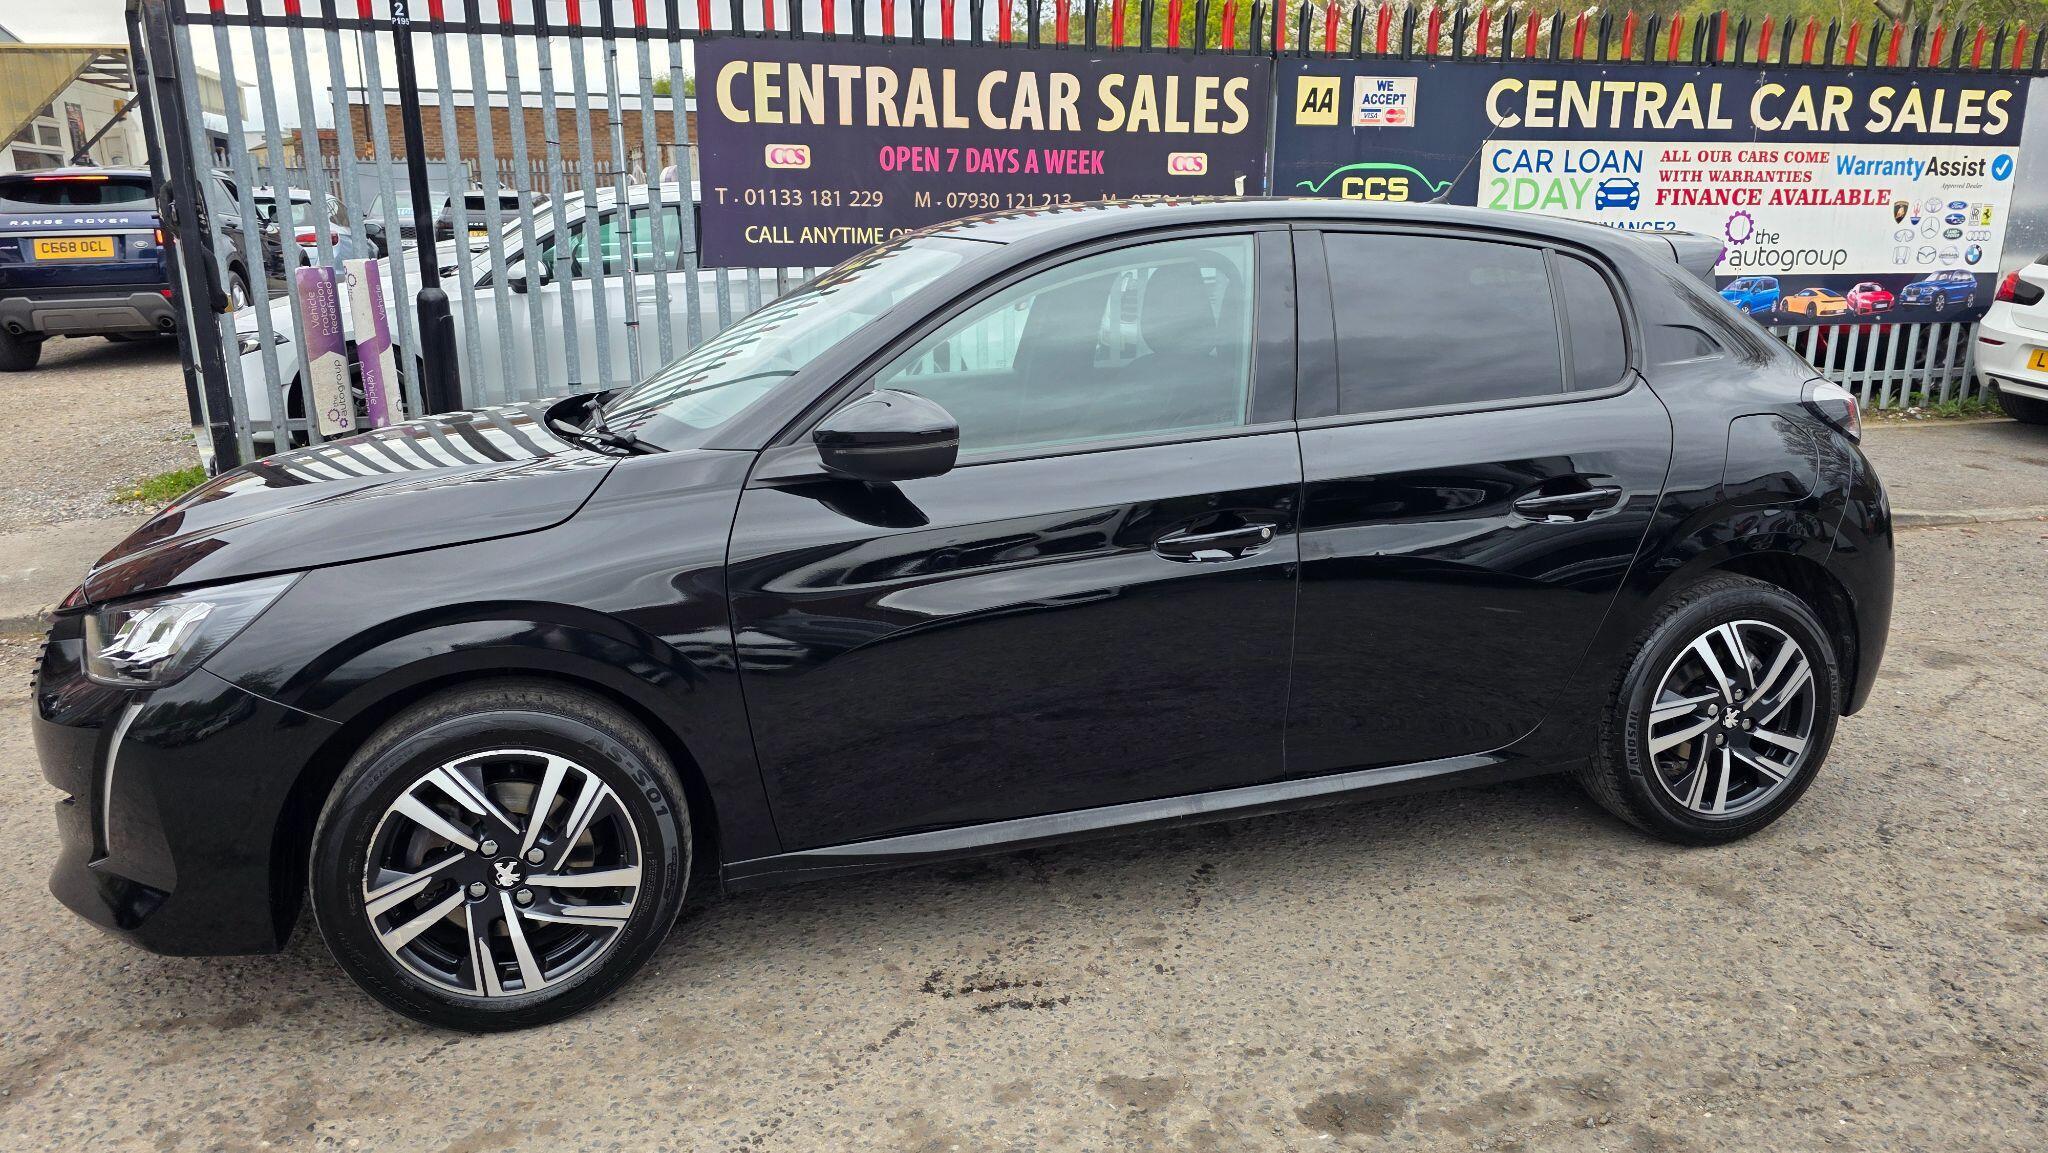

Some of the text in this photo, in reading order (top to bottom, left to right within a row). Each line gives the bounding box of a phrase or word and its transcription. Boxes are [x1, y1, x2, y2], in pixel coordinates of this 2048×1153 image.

[394, 2, 404, 16] 2
[716, 60, 1250, 134] CENTRAL CAR SALES
[1377, 80, 1394, 92] WE
[1301, 87, 1333, 113] AA
[1362, 94, 1406, 105] ACCEPT
[1485, 78, 2013, 136] CENTRAL CAR SALES
[771, 148, 805, 165] CCS
[879, 145, 1105, 175] OPEN 7 DAYS A WEEK
[1172, 156, 1203, 173] CCS
[1492, 149, 1643, 174] CAR LOAN
[1660, 150, 1830, 164] ALL OUR CARS COME
[1341, 176, 1409, 201] CCS
[1659, 170, 1813, 183] WITH WARRANTIES
[715, 188, 728, 205] T
[744, 188, 803, 206] 01133
[810, 190, 840, 207] 181
[849, 191, 883, 207] 229
[914, 192, 931, 208] M
[946, 192, 999, 209] 07930
[1006, 193, 1033, 208] 121
[1488, 177, 1594, 212] 2DAY
[1654, 188, 1892, 206] FINANCE AVAILABLE
[745, 226, 794, 244] CALL
[800, 227, 884, 244] ANYTIME
[1755, 229, 1780, 245] the
[41, 241, 107, 254] CE68 OCL
[1729, 247, 1848, 271] autogroup
[309, 291, 319, 328] Vehicle
[318, 281, 330, 336] Protection
[326, 281, 338, 334] Redefined
[333, 359, 348, 417] autogroup
[366, 369, 377, 405] Vehicle
